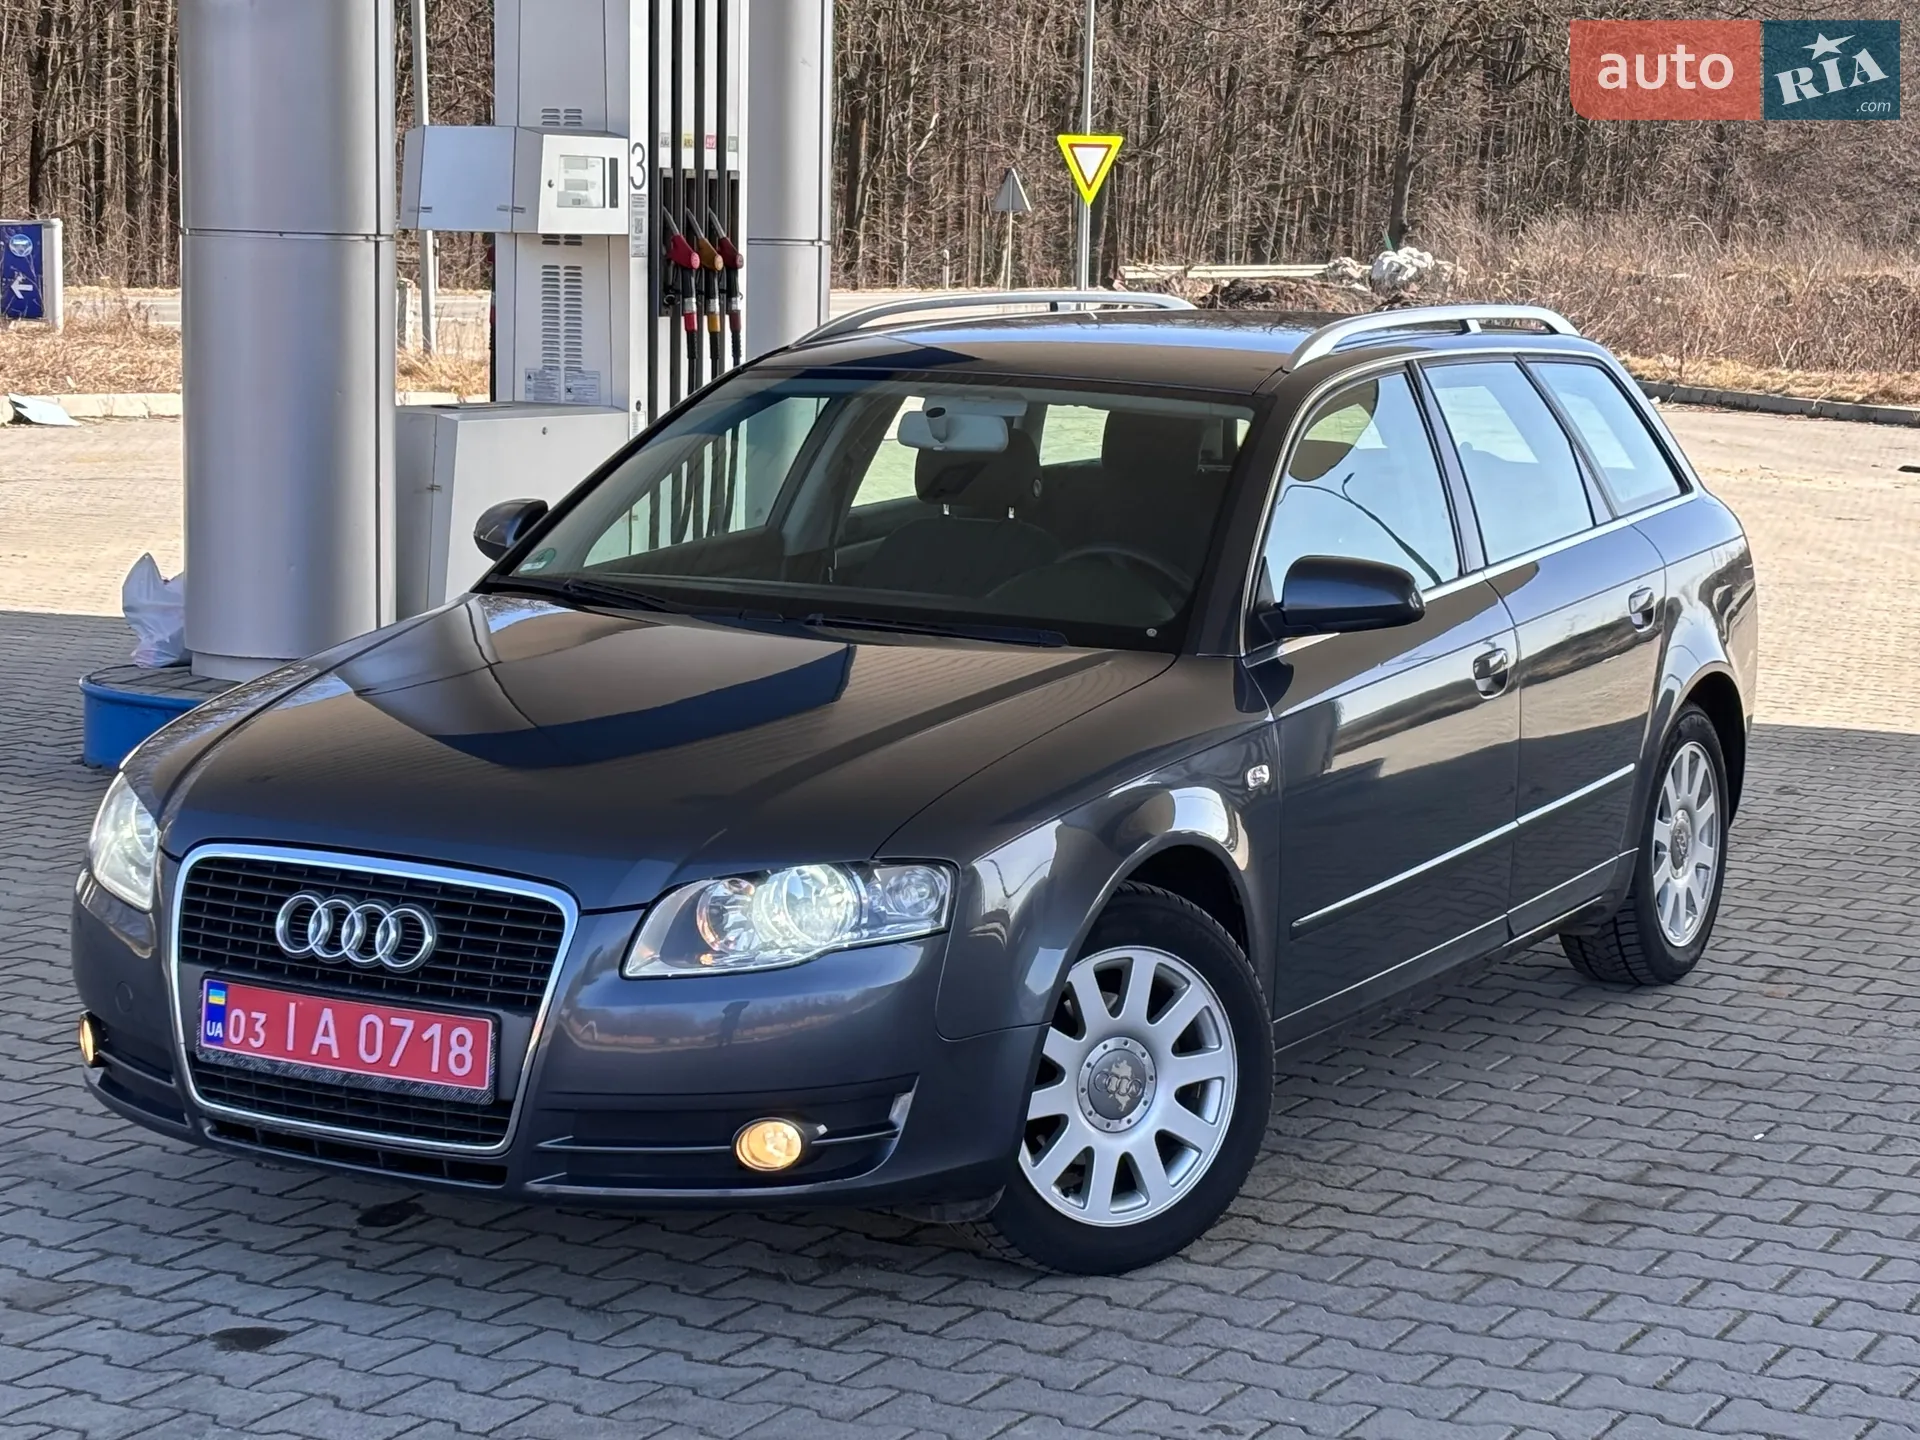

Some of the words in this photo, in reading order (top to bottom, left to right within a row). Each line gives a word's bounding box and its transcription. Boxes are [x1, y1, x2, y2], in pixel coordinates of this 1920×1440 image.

[630, 142, 646, 190] 3
[206, 1020, 223, 1038] UA
[228, 1008, 267, 1048] 03
[358, 1013, 474, 1077] 0718
